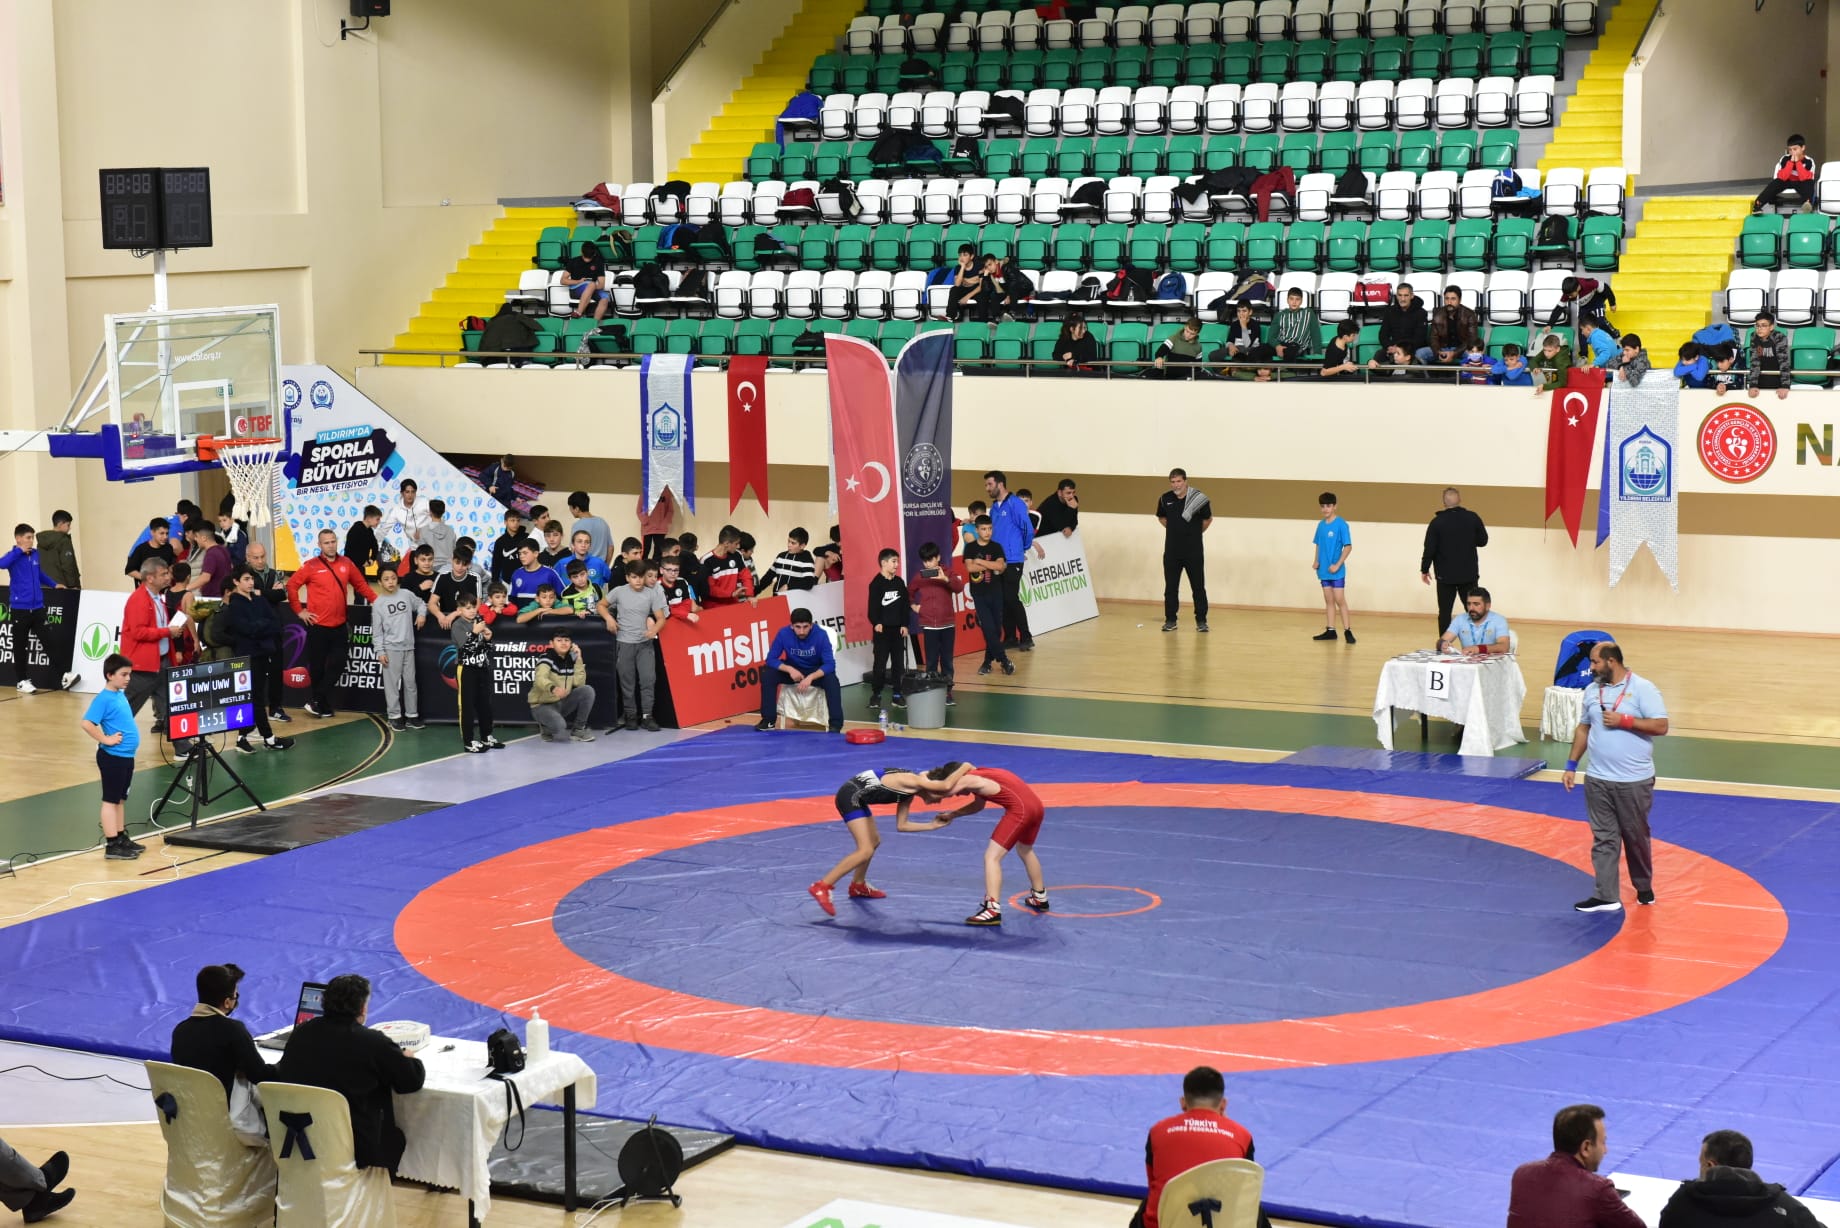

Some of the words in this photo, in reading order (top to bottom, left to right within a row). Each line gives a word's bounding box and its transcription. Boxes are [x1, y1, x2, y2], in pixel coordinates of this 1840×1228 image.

[248, 415, 272, 433] TBF
[310, 440, 374, 462] SPORLA
[1797, 423, 1840, 466] N
[302, 458, 379, 483] BÜYÜYEN
[1029, 558, 1083, 586] HERBALIFE
[1033, 574, 1087, 602] NUTRITION
[388, 601, 406, 614] DG
[688, 620, 770, 676] misli
[493, 655, 540, 668] TÜRKİ
[182, 668, 193, 677] 120
[207, 665, 213, 674] 0
[212, 678, 230, 690] UWW
[291, 674, 306, 682] TBF
[335, 673, 375, 689] ÜPER
[1429, 670, 1444, 691] B
[192, 681, 210, 693] UWW
[494, 680, 520, 694] LİGİ
[170, 702, 197, 712] WRESTLER
[219, 694, 245, 705] WRESTLER
[199, 711, 226, 728] 1:51
[235, 708, 244, 723] 4
[180, 718, 188, 733] 0
[1184, 1118, 1218, 1128] TÜRKİYE
